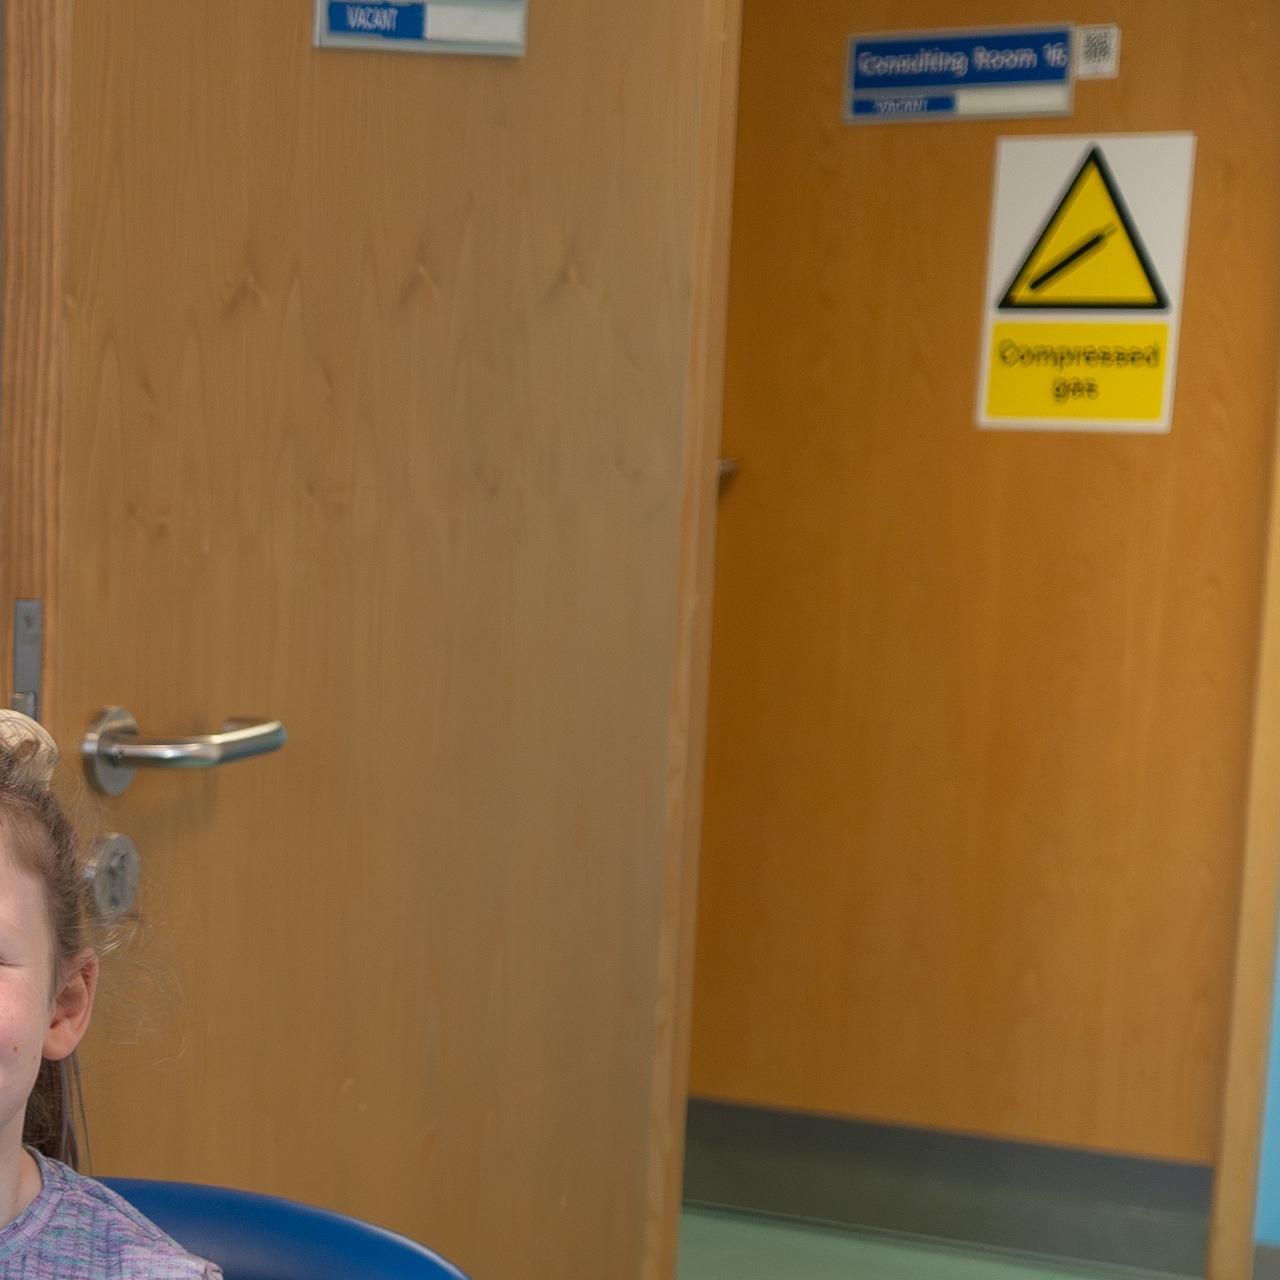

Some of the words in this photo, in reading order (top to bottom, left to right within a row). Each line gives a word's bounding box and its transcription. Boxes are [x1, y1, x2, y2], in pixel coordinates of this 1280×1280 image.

[346, 4, 398, 31] VACANT
[858, 47, 969, 77] Consulting
[972, 46, 1038, 70] Room
[1041, 42, 1068, 68] 16
[998, 338, 1161, 370] Compressed
[1052, 378, 1099, 405] gas
